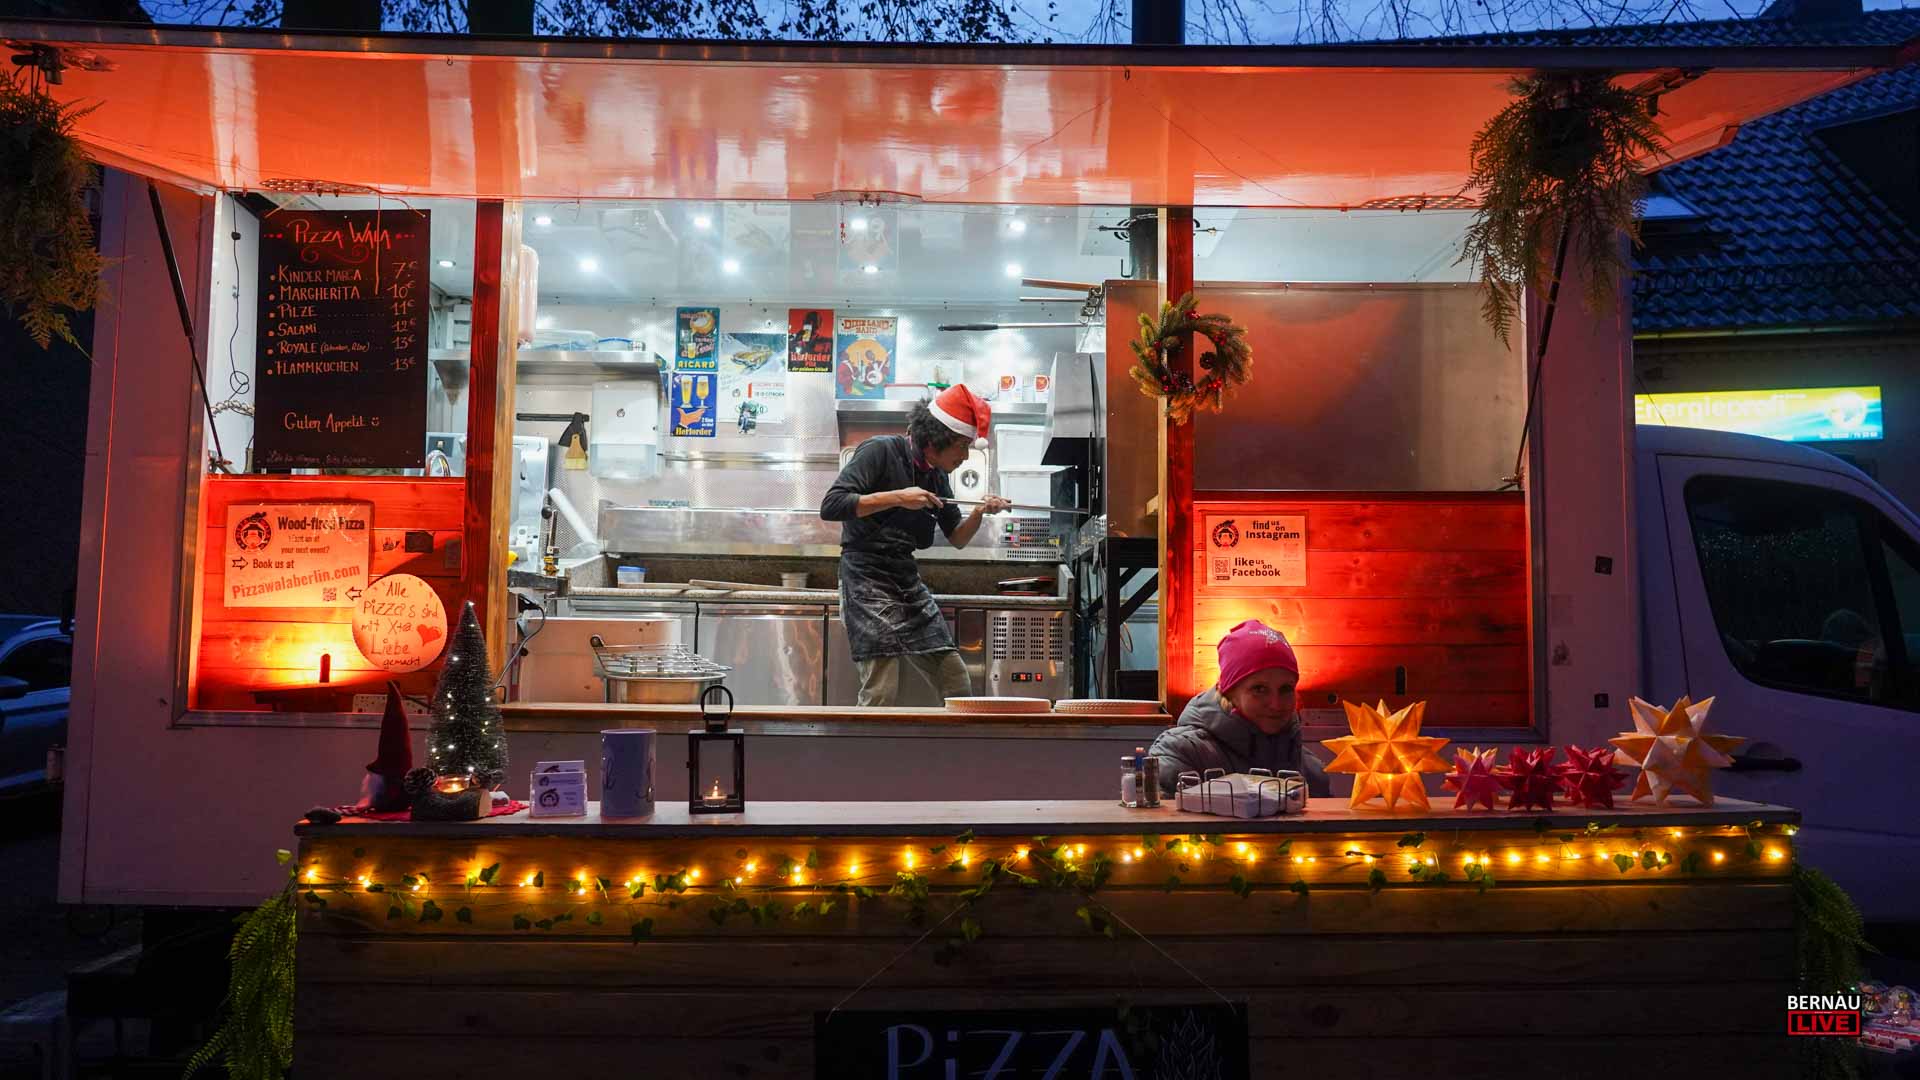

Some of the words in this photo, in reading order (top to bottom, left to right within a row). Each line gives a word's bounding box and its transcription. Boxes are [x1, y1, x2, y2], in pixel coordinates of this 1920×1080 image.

[279, 264, 321, 283] KINDER
[277, 340, 318, 354] ROYALE
[790, 352, 830, 361] Herforder
[275, 360, 359, 375] FLAMMKUCHEN
[678, 361, 715, 369] RICARD
[675, 427, 712, 436] Herforder
[338, 516, 365, 530] Pizza
[1252, 520, 1270, 530] find
[1246, 531, 1300, 541] Instagram
[253, 558, 272, 569] Book
[275, 560, 284, 569] us
[285, 559, 294, 569] at
[1234, 557, 1254, 566] like
[1232, 568, 1281, 576] Facebook
[232, 565, 360, 599] Pizzawalaberlin.com
[386, 580, 408, 598] Alle
[361, 619, 379, 632] mit
[371, 633, 409, 655] Liebe
[384, 656, 420, 669] gemacht
